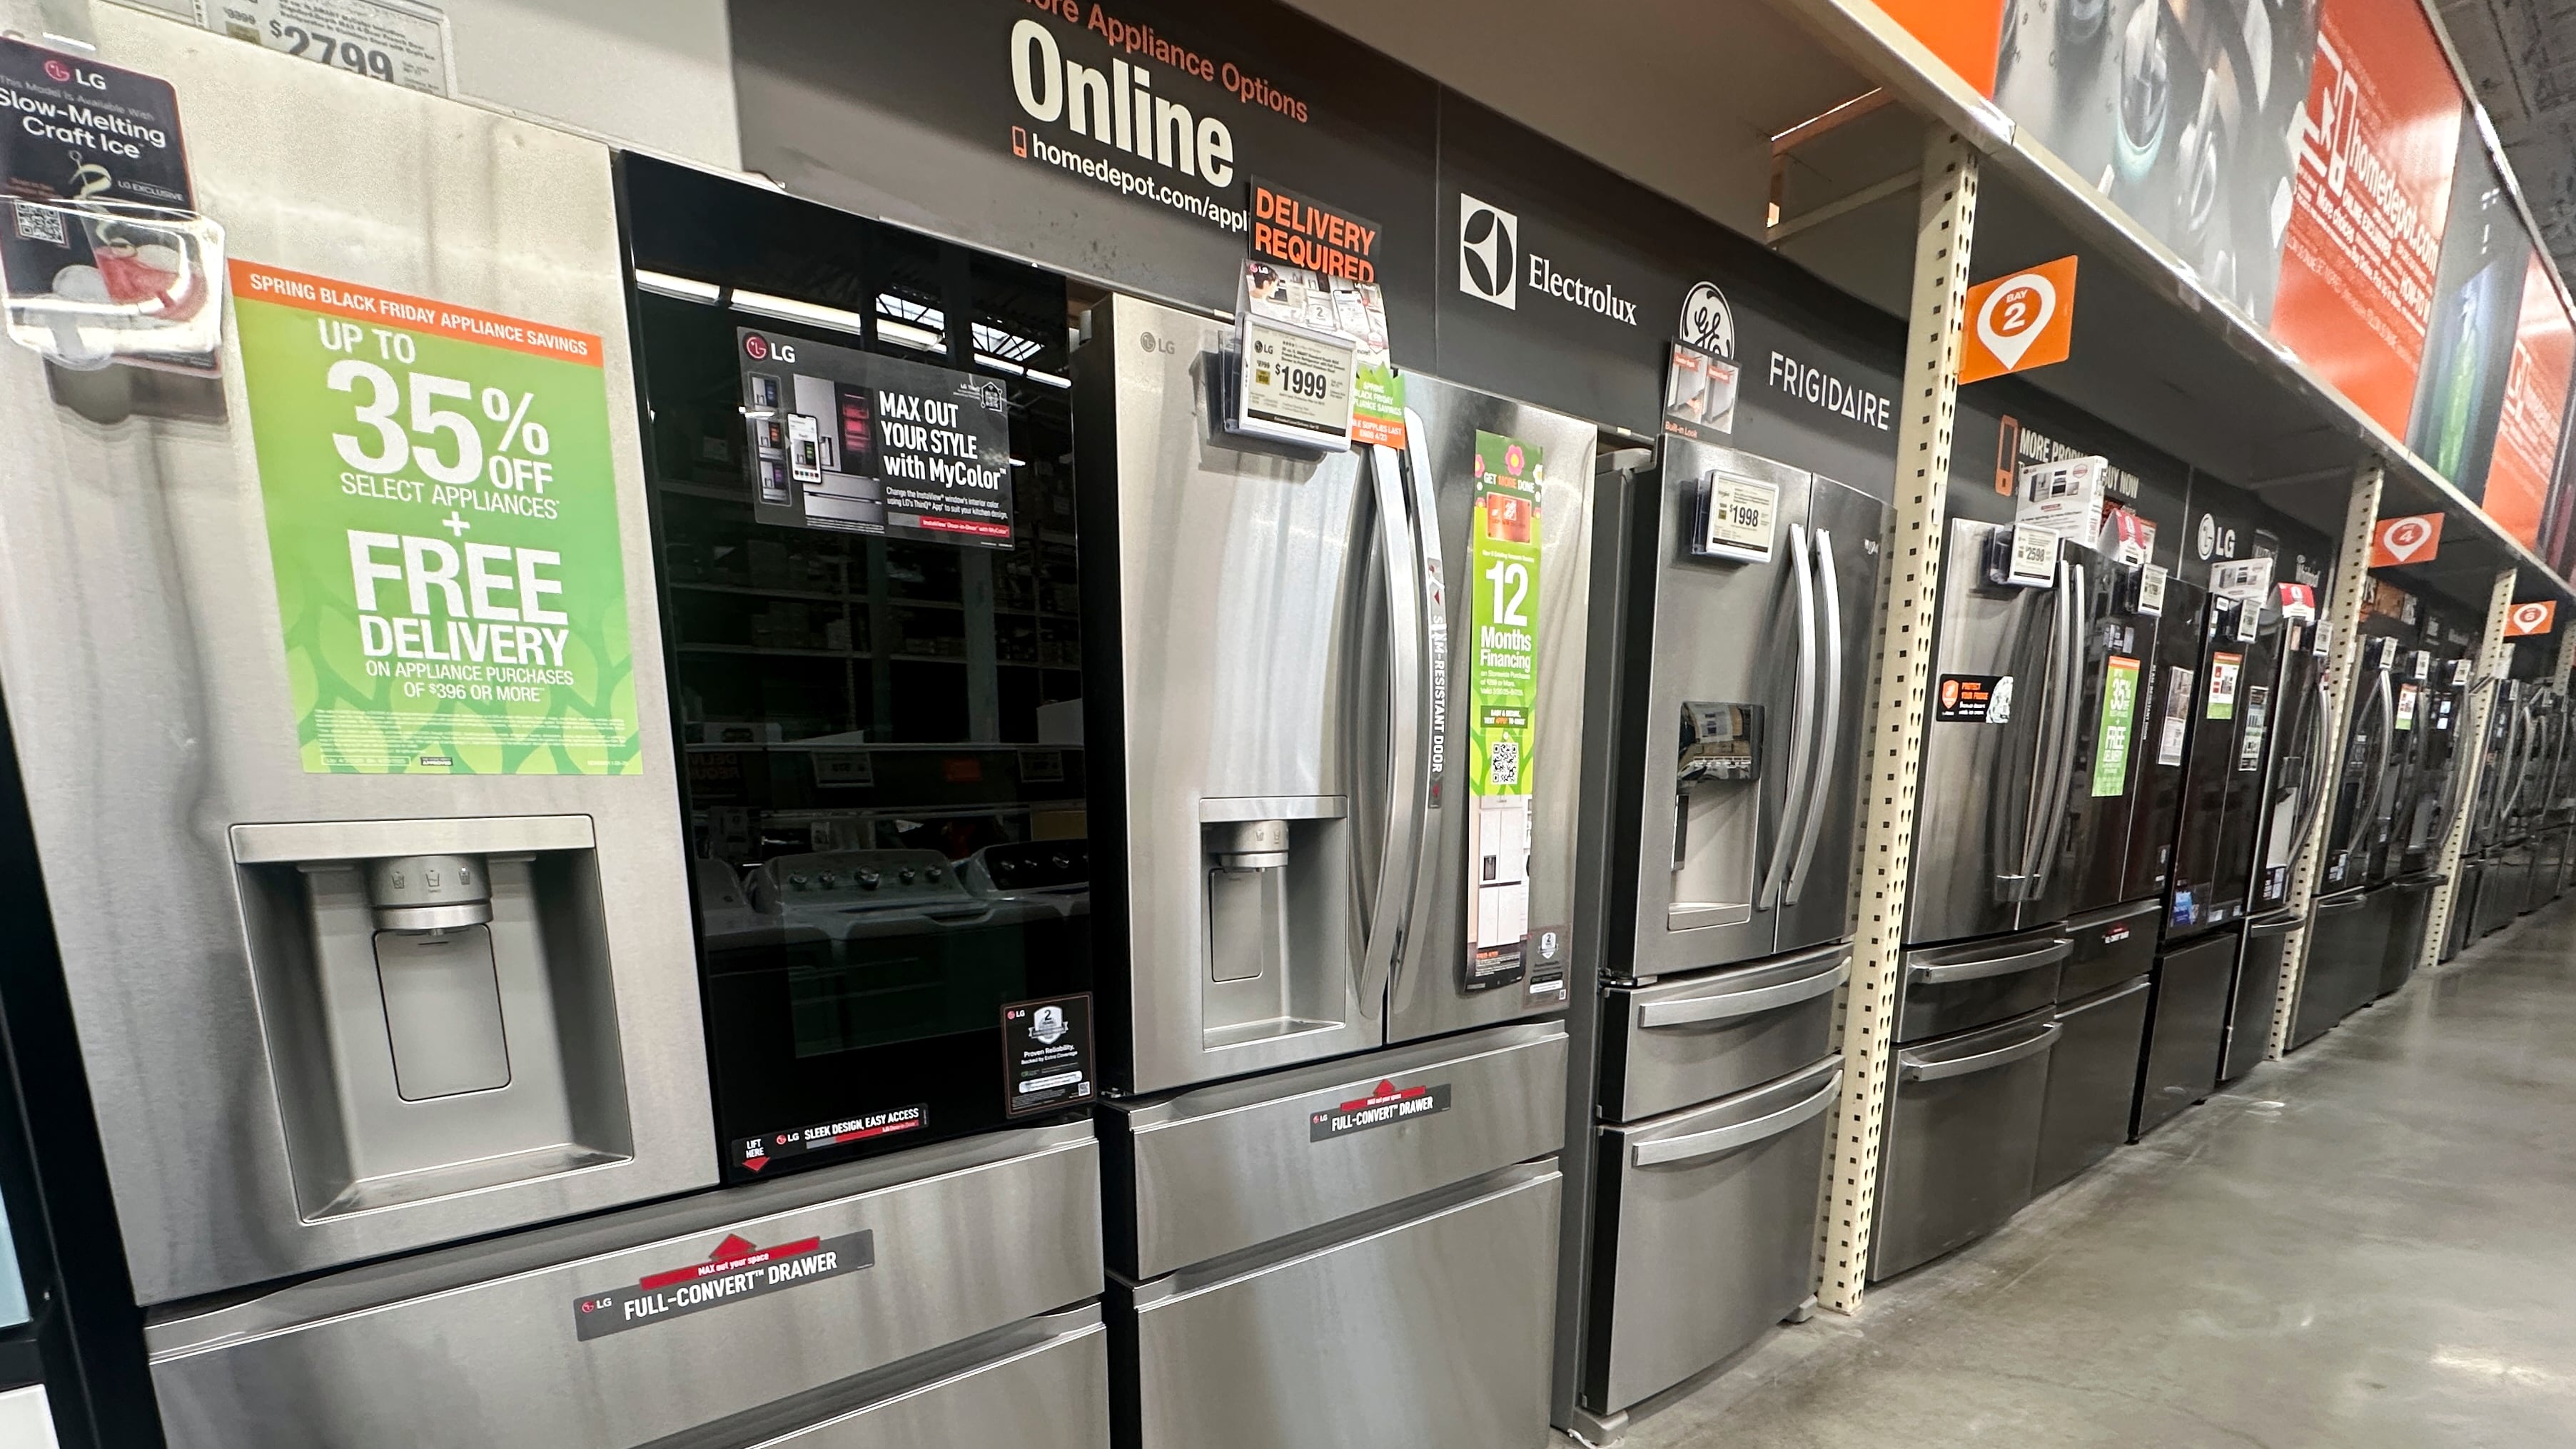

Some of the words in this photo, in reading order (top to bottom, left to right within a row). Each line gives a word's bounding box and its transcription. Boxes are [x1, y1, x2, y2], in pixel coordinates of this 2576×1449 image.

[269, 19, 394, 83] $2799
[1088, 6, 1215, 81] Appliance
[1221, 63, 1308, 123] Options
[75, 69, 106, 90] LG
[26, 81, 61, 98] Model
[78, 95, 126, 113] Available
[128, 108, 155, 121] With
[1011, 19, 1233, 188] Online
[0, 86, 166, 148] Slow-Melting
[23, 116, 96, 148] Craft
[132, 183, 184, 201] EXCLUSIVE
[2348, 117, 2438, 277] homedepot.com
[1256, 186, 1376, 258] DELIVERY
[1255, 222, 1375, 283] REQUIRED
[1528, 253, 1637, 325] Electrolux
[2006, 289, 2029, 303] BAY
[250, 273, 316, 301] SPRING
[320, 287, 376, 313] BLACK
[380, 299, 435, 325] FRIDAY
[440, 311, 524, 343] APPLIANCE
[527, 329, 588, 357] SAVINGS
[2002, 302, 2026, 331] 2
[318, 318, 364, 353] UP
[372, 328, 415, 364] TO
[771, 343, 796, 363] LG
[1158, 338, 1175, 354] LG
[1263, 344, 1273, 355] LG
[1275, 363, 1326, 400] $1999
[1769, 350, 1891, 431] FRIGIDAIRE
[879, 390, 921, 423] MAX
[924, 399, 959, 429] OUT
[880, 420, 930, 451] YOUR
[931, 430, 979, 460] STYLE
[2019, 427, 2051, 463] MORE
[488, 455, 553, 494] OFF
[884, 454, 926, 481] with
[341, 473, 425, 504] SELECT
[886, 486, 906, 498] Change
[907, 489, 916, 499] the
[969, 498, 986, 508] interior
[1484, 472, 1497, 485] GET
[1517, 479, 1535, 493] DONE
[2118, 470, 2139, 499] NOW
[887, 498, 902, 508] using
[961, 507, 971, 515] your
[972, 507, 991, 517] kitchen
[1729, 504, 1759, 527] $1998
[2215, 526, 2236, 558] LG
[2399, 530, 2414, 543] 4
[347, 529, 569, 625] FREE
[1485, 560, 1529, 627] 12
[358, 614, 569, 667] DELIVERY
[1480, 625, 1532, 652] Months
[365, 660, 390, 677] ON
[395, 662, 483, 682] APPLIANCE
[486, 665, 575, 686] PURCHASES
[1480, 648, 1532, 673] Financing
[404, 681, 425, 698] OF
[428, 682, 466, 700] $396
[470, 685, 493, 701] OR
[1432, 734, 1445, 773] DOOR
[1044, 1009, 1052, 1021] 2
[1024, 1049, 1045, 1058] Proven
[1057, 1051, 1079, 1059] Coverage
[1399, 1096, 1433, 1116] DRAWER
[787, 1132, 799, 1142] LG
[804, 1126, 831, 1141] SLEEK
[832, 1119, 864, 1135] DESIGN,
[865, 1114, 887, 1129] EASY
[887, 1108, 919, 1123] ACCESS
[745, 1147, 764, 1158] HERE
[746, 1138, 762, 1150] LIFT
[698, 1264, 715, 1276] MAX
[715, 1261, 729, 1272] out
[729, 1258, 747, 1270] your
[747, 1253, 769, 1265] space
[768, 1251, 837, 1285] DRAWER
[596, 1297, 612, 1309] LG
